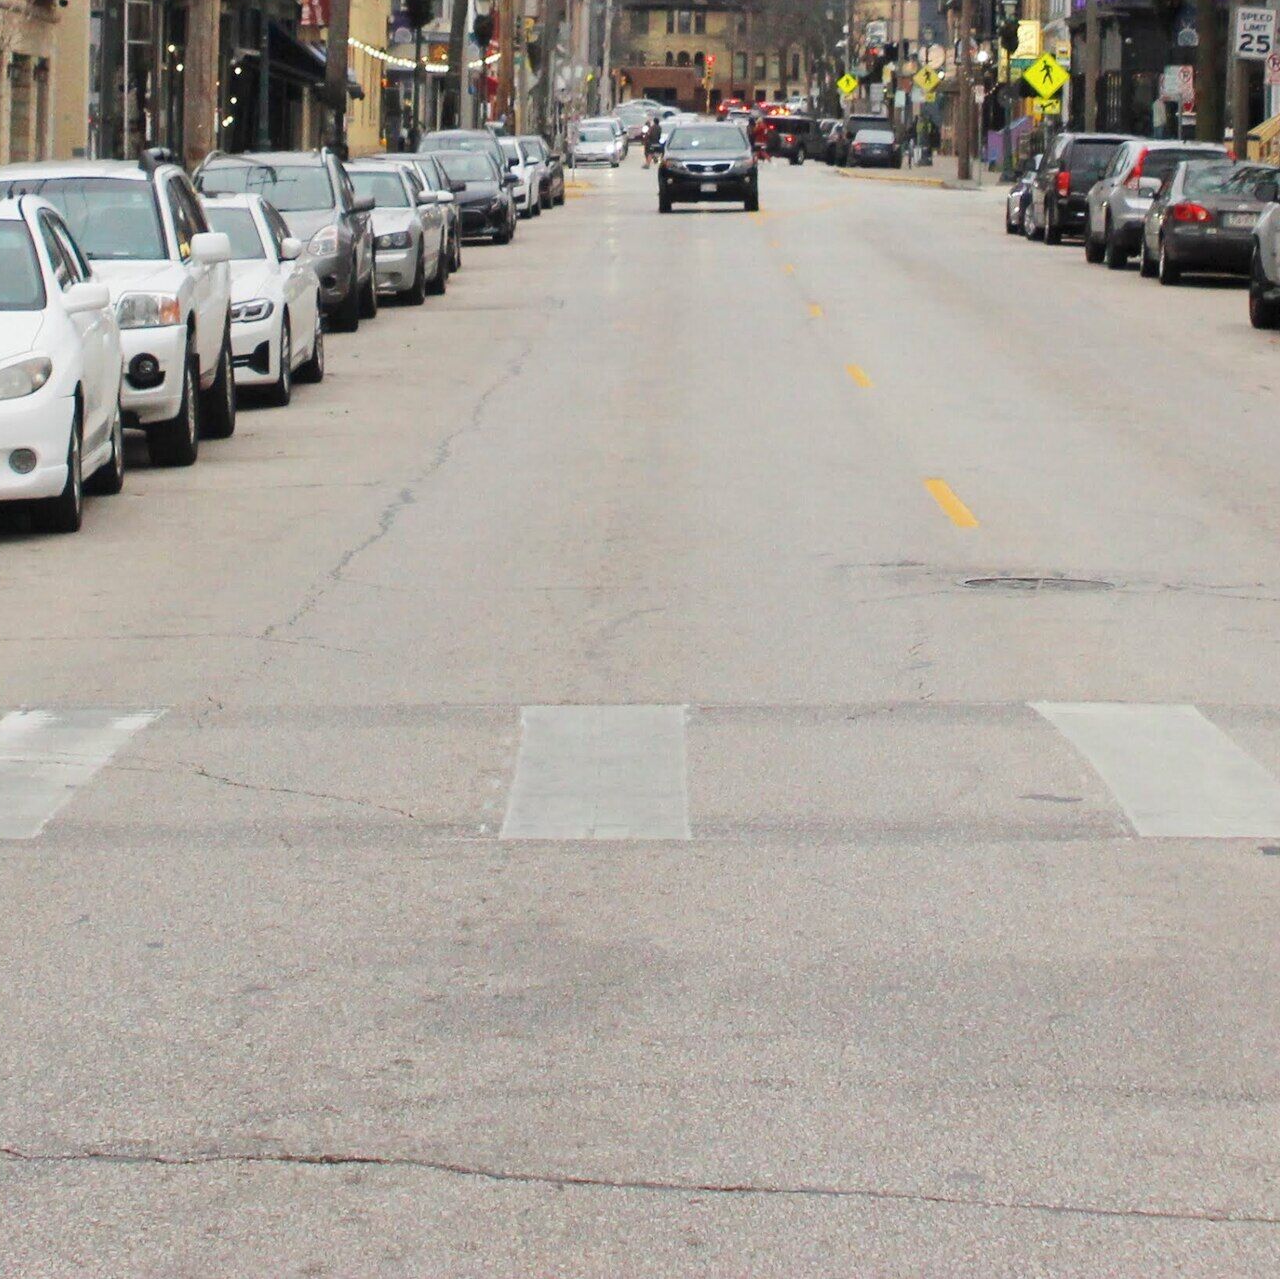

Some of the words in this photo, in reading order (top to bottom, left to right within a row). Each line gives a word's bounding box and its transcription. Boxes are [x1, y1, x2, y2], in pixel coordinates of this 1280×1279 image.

[1241, 12, 1273, 22] SPEED
[1243, 23, 1267, 31] LIMIT
[1240, 33, 1270, 54] 25
